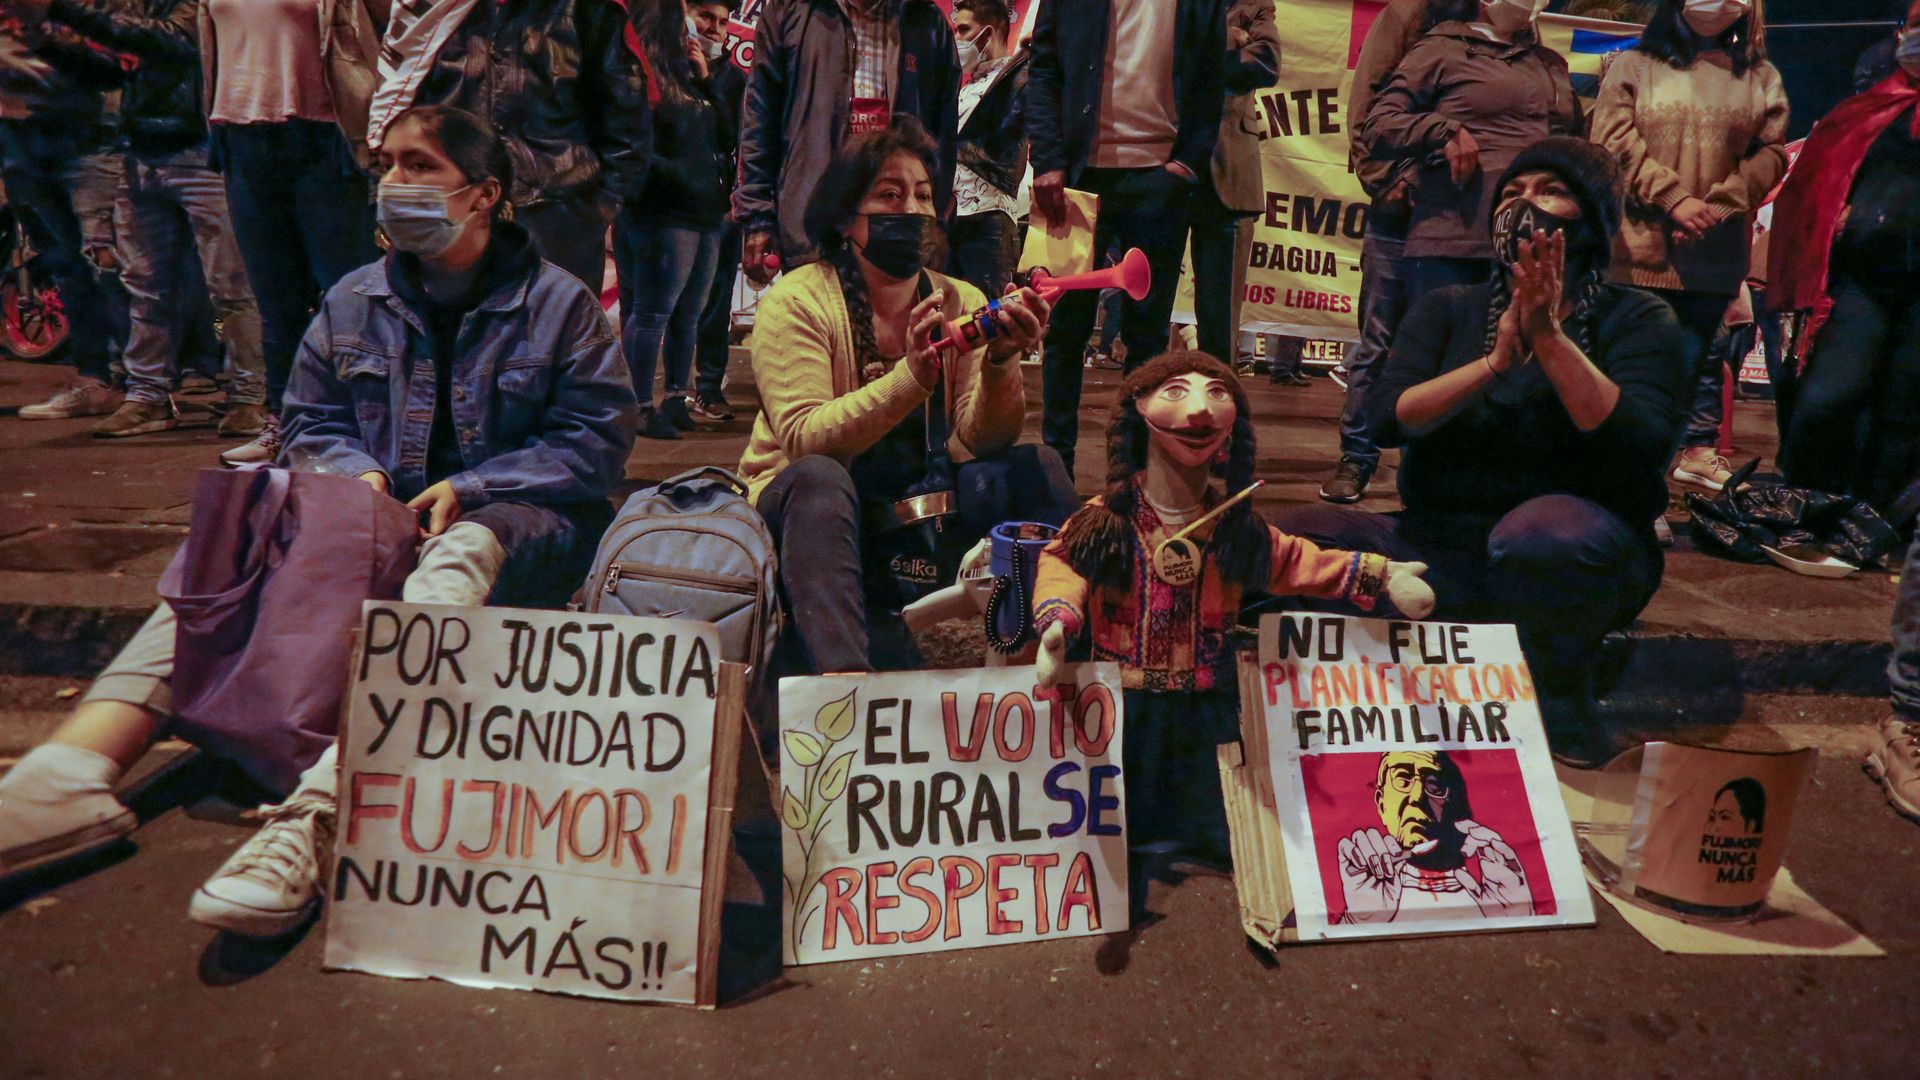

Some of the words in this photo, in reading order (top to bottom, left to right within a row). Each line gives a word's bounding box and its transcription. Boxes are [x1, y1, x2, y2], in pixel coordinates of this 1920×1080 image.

[1249, 241, 1337, 278] BAGUA
[1285, 288, 1352, 314] LIBRES
[358, 607, 471, 686] POR
[494, 620, 718, 699] JUSTICIA
[1278, 615, 1346, 662] NO
[1389, 622, 1476, 665] FUE
[366, 692, 405, 757] Y
[415, 697, 687, 772] DIGNIDAD
[864, 698, 930, 765] EL
[941, 682, 1116, 762] VOTO
[1295, 698, 1512, 750] FAMILIAR
[346, 771, 687, 875] FUJIMORI
[847, 771, 1042, 855] RURAL
[1043, 761, 1123, 839] SE
[335, 856, 551, 921] NUNCA
[1698, 848, 1757, 866] NUNCA
[819, 851, 1103, 950] RESPETA
[480, 916, 668, 991] MÁS!!
